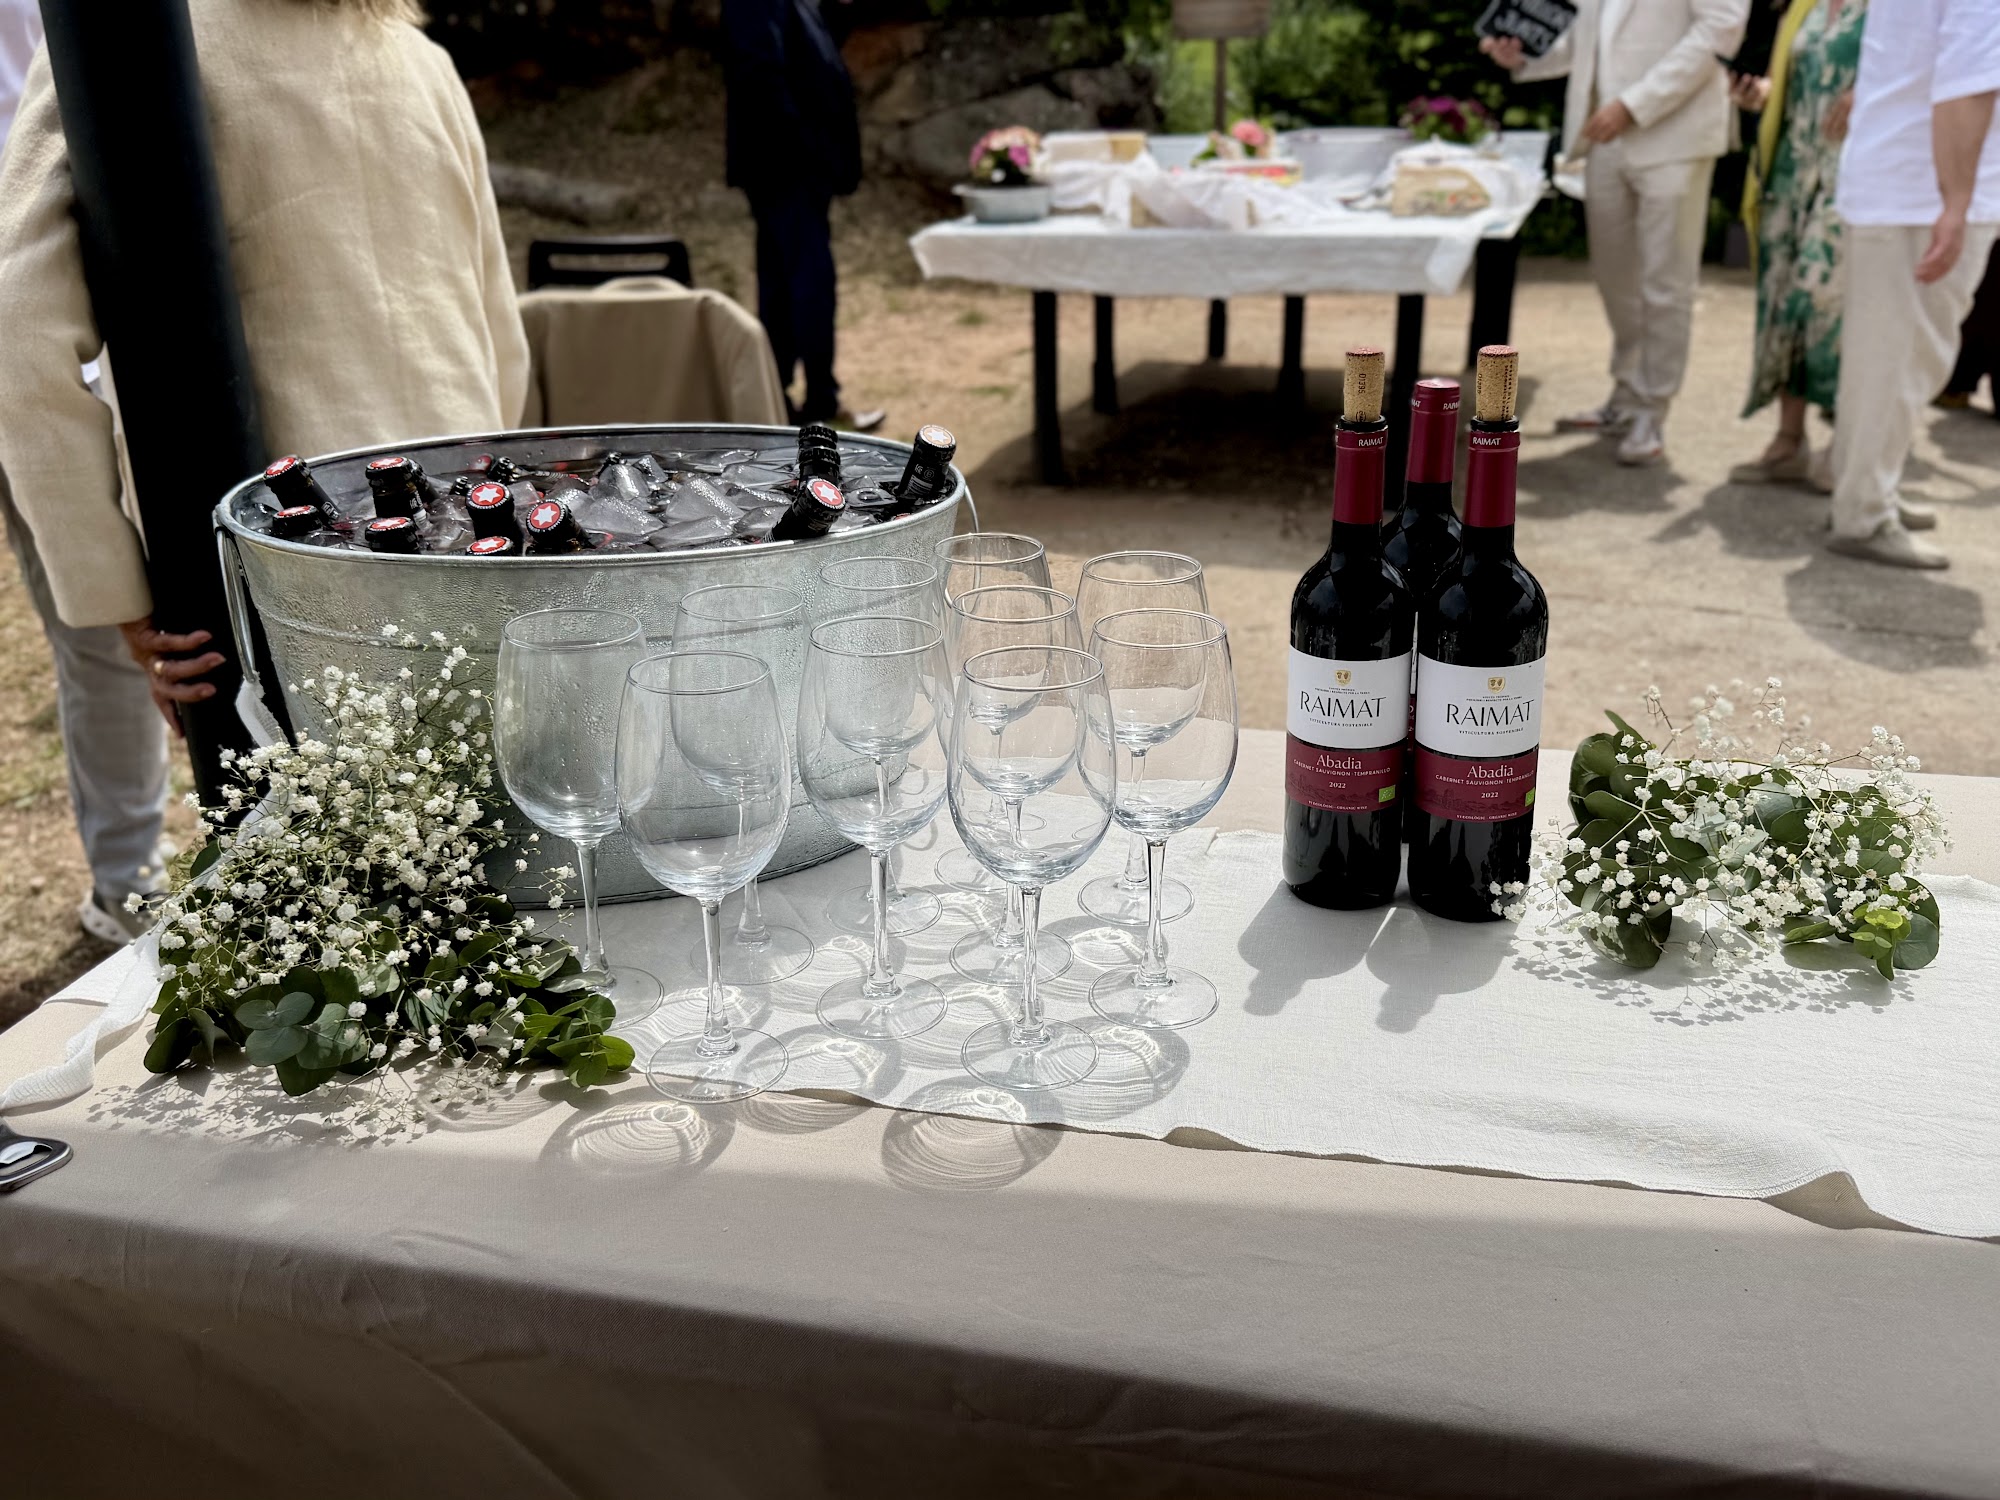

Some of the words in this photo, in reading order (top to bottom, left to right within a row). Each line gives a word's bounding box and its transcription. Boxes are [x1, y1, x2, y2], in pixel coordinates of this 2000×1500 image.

[1357, 373, 1367, 394] 01395
[1358, 436, 1384, 447] RAIMAT
[1472, 436, 1502, 446] RAIMAT
[1300, 690, 1387, 719] RAIMAT
[1446, 699, 1535, 727] RAIMAT
[1293, 759, 1315, 771] CABERNET
[1315, 767, 1351, 777] SAUVIGNON
[1354, 767, 1391, 777] TEMPRANILLO
[1316, 754, 1362, 770] Abadia
[1435, 774, 1464, 784] CABERNET
[1506, 770, 1535, 783] TEMPRANILLO
[1467, 764, 1514, 779] Abadia
[1328, 781, 1346, 789] 2022
[1481, 791, 1499, 799] 2022
